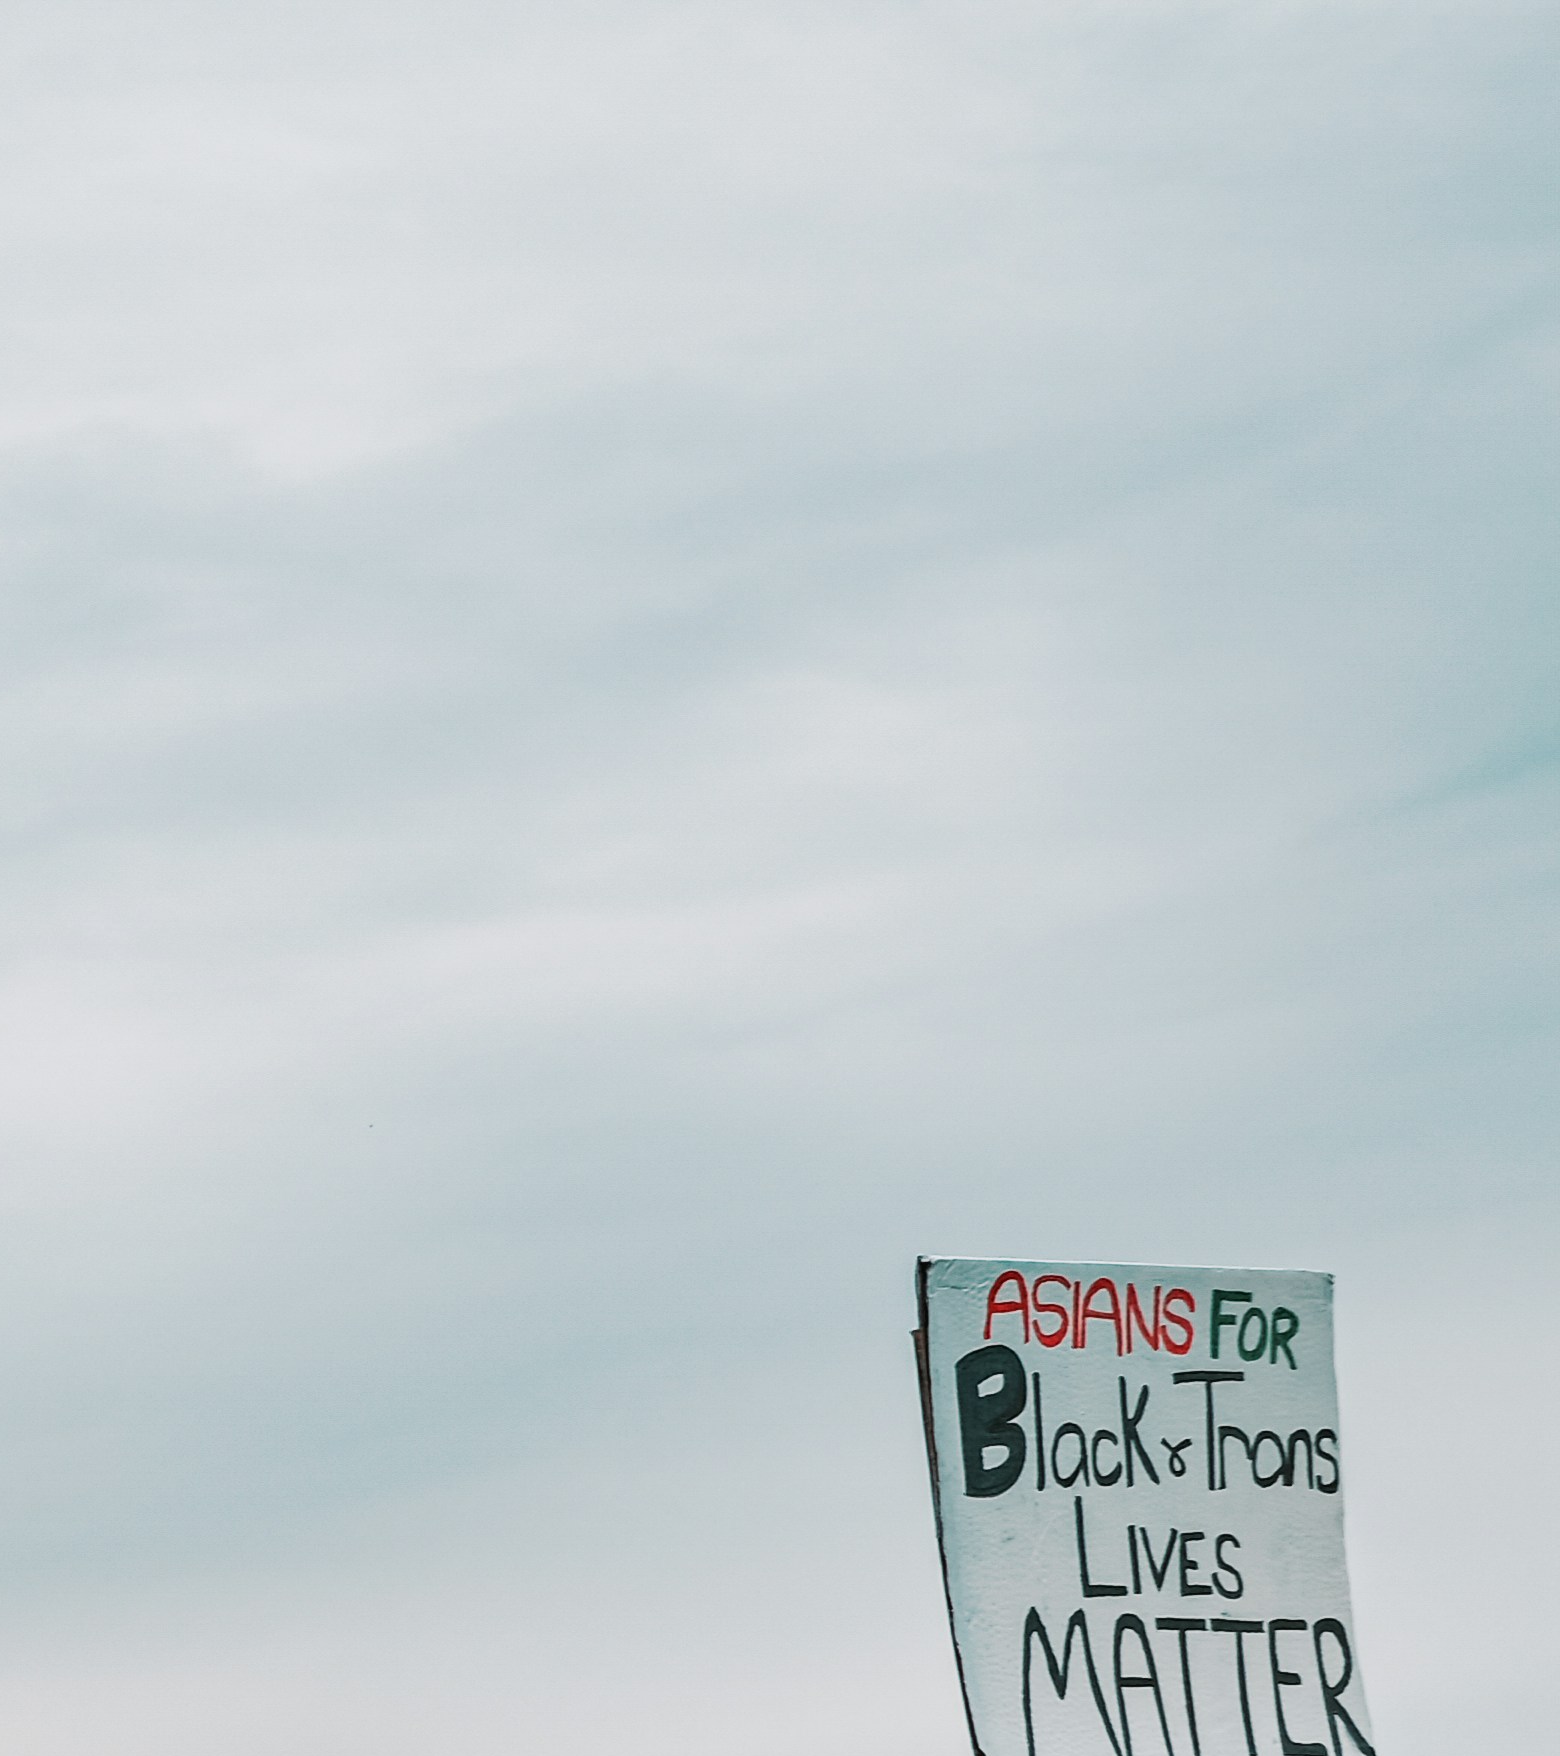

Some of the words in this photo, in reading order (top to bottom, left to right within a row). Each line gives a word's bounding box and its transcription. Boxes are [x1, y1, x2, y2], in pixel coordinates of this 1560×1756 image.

[982, 1270, 1196, 1357] ASIANS
[1209, 1288, 1300, 1371] FOR
[1173, 1370, 1340, 1494] Trans
[1075, 1496, 1244, 1600] LIVES
